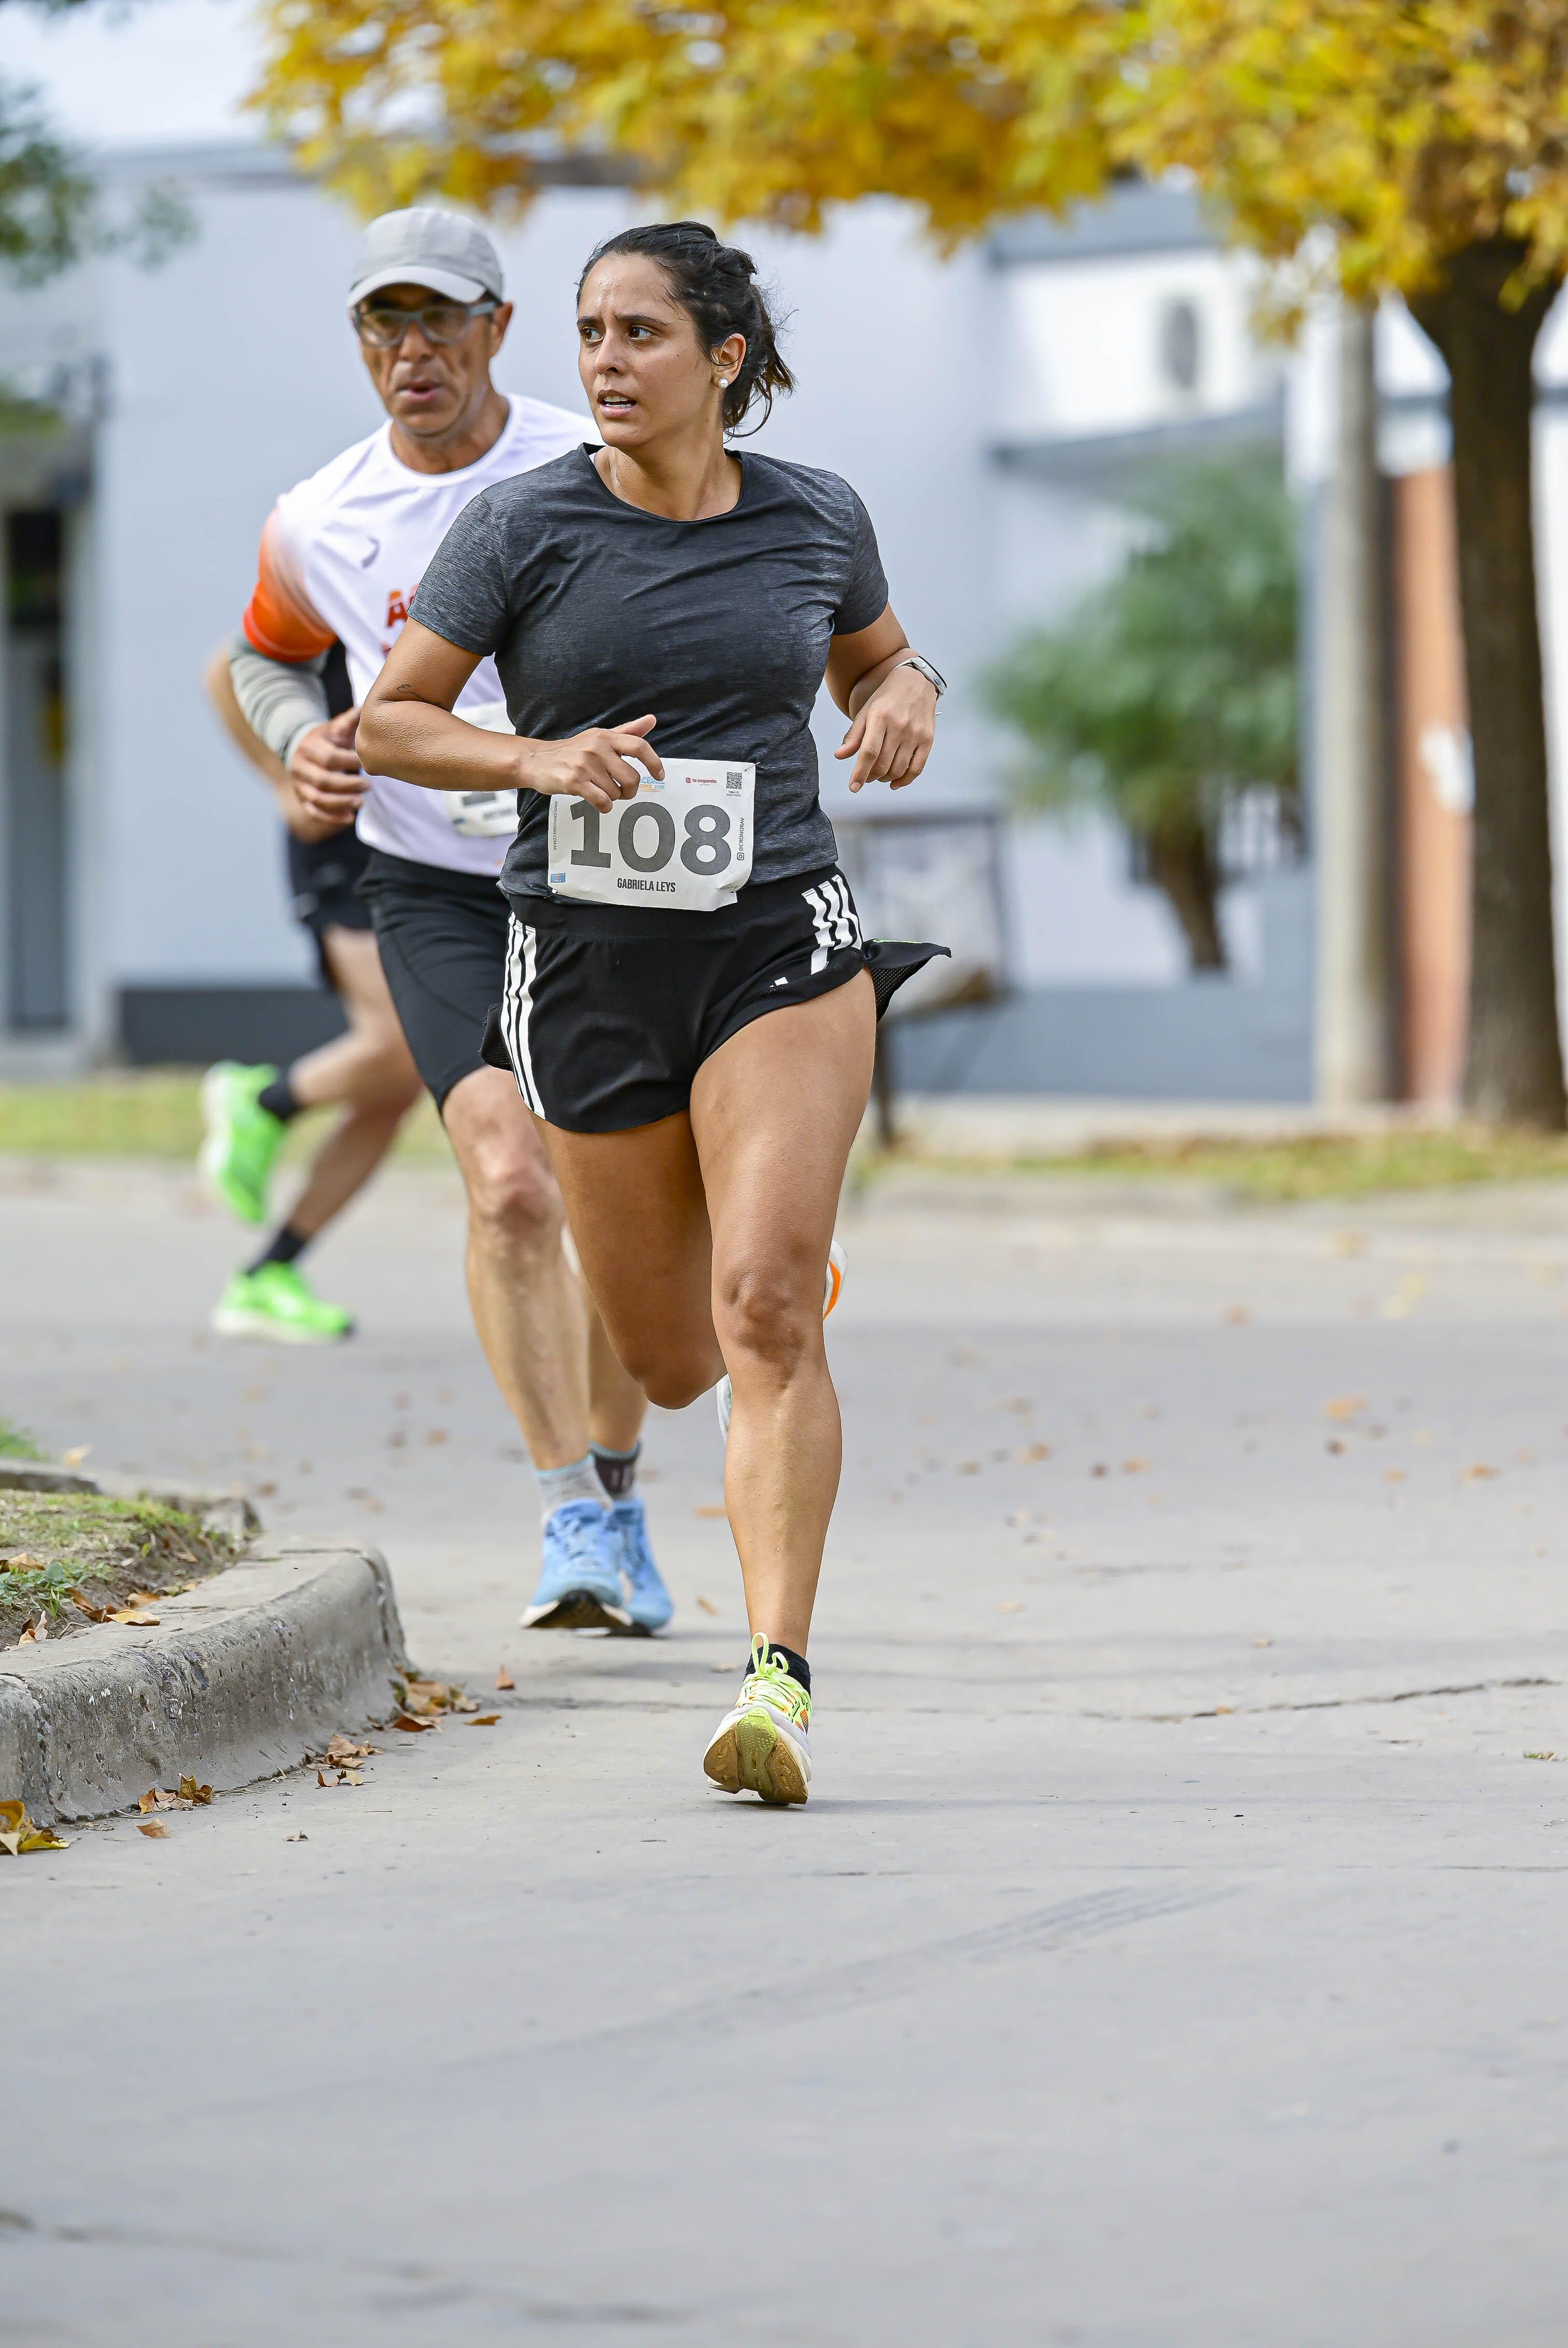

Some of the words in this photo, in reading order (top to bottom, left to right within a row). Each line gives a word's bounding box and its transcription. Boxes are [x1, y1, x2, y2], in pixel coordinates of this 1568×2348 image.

[570, 800, 732, 876] 108
[617, 877, 654, 891] GABRIELA
[656, 882, 676, 892] LEYS
